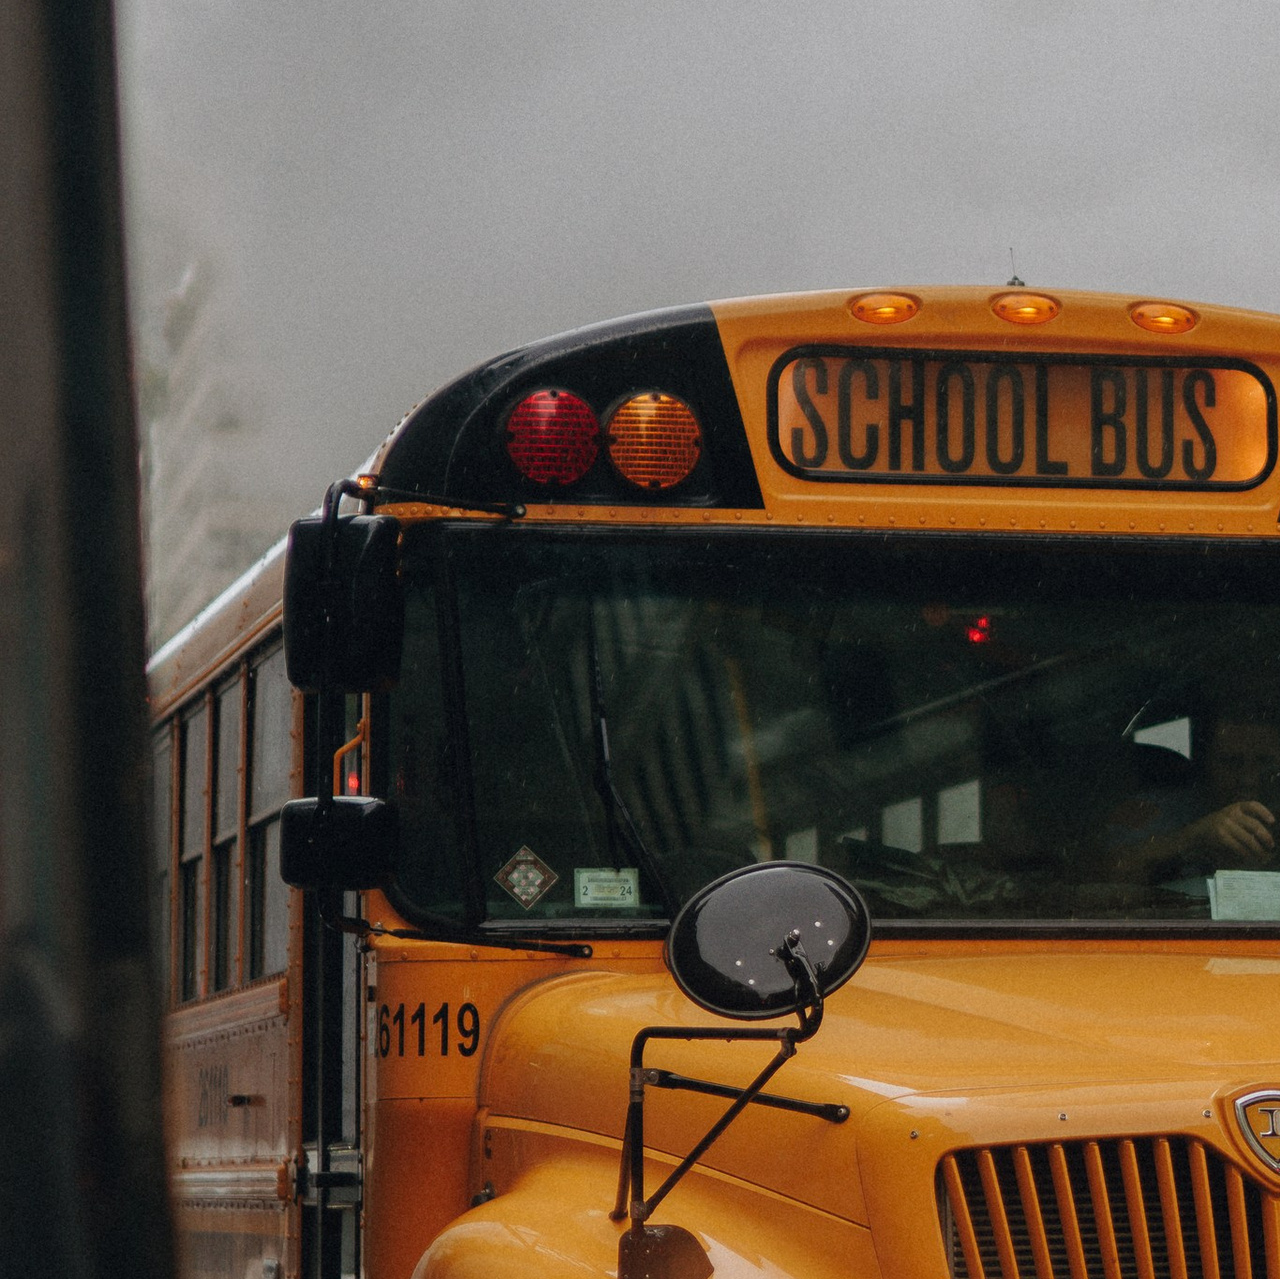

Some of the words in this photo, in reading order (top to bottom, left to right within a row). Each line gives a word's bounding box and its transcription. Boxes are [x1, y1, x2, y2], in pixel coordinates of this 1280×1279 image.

[790, 355, 1069, 476] SCHOOL
[1091, 365, 1217, 481] BUS
[620, 885, 632, 896] 24
[375, 1002, 480, 1058] 61119
